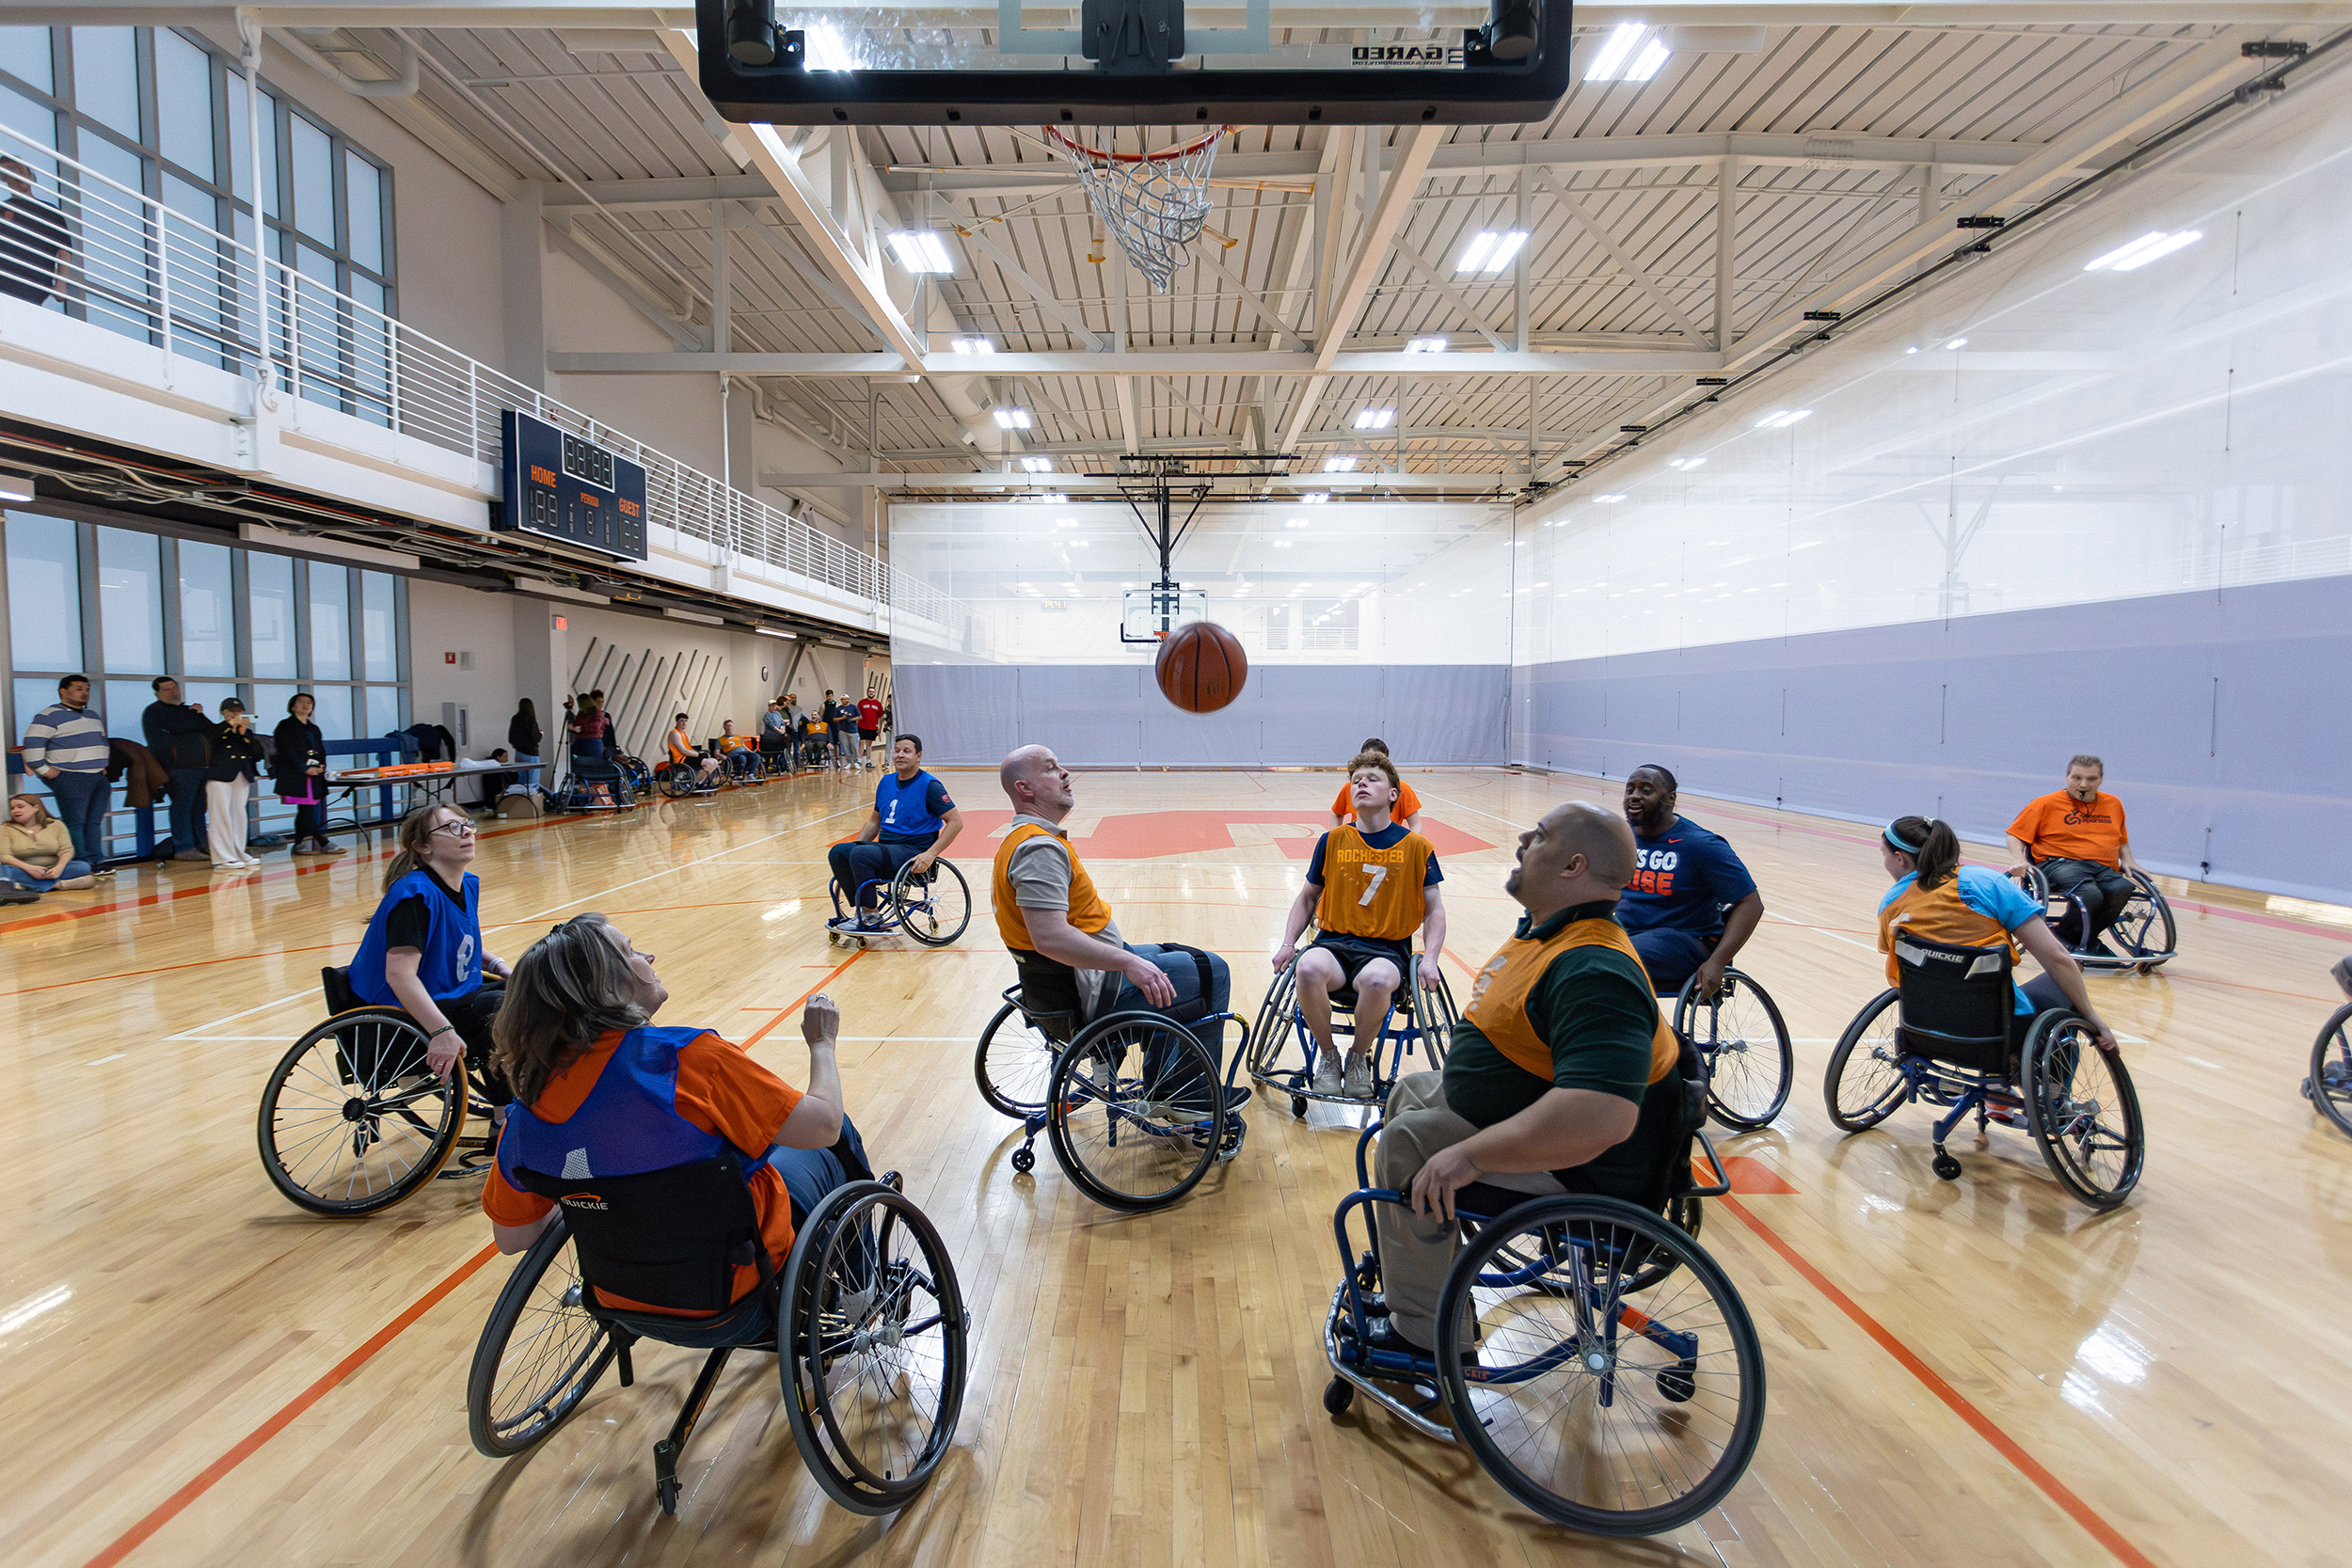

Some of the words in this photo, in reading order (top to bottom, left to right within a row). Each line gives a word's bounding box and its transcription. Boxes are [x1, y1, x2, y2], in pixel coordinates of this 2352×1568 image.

[531, 465, 557, 488] HOME
[618, 498, 640, 517] GUEST
[884, 799, 898, 824] 1
[1337, 849, 1405, 863] ROCHESTER
[1649, 850, 1677, 872] GO
[1358, 863, 1387, 907] 7
